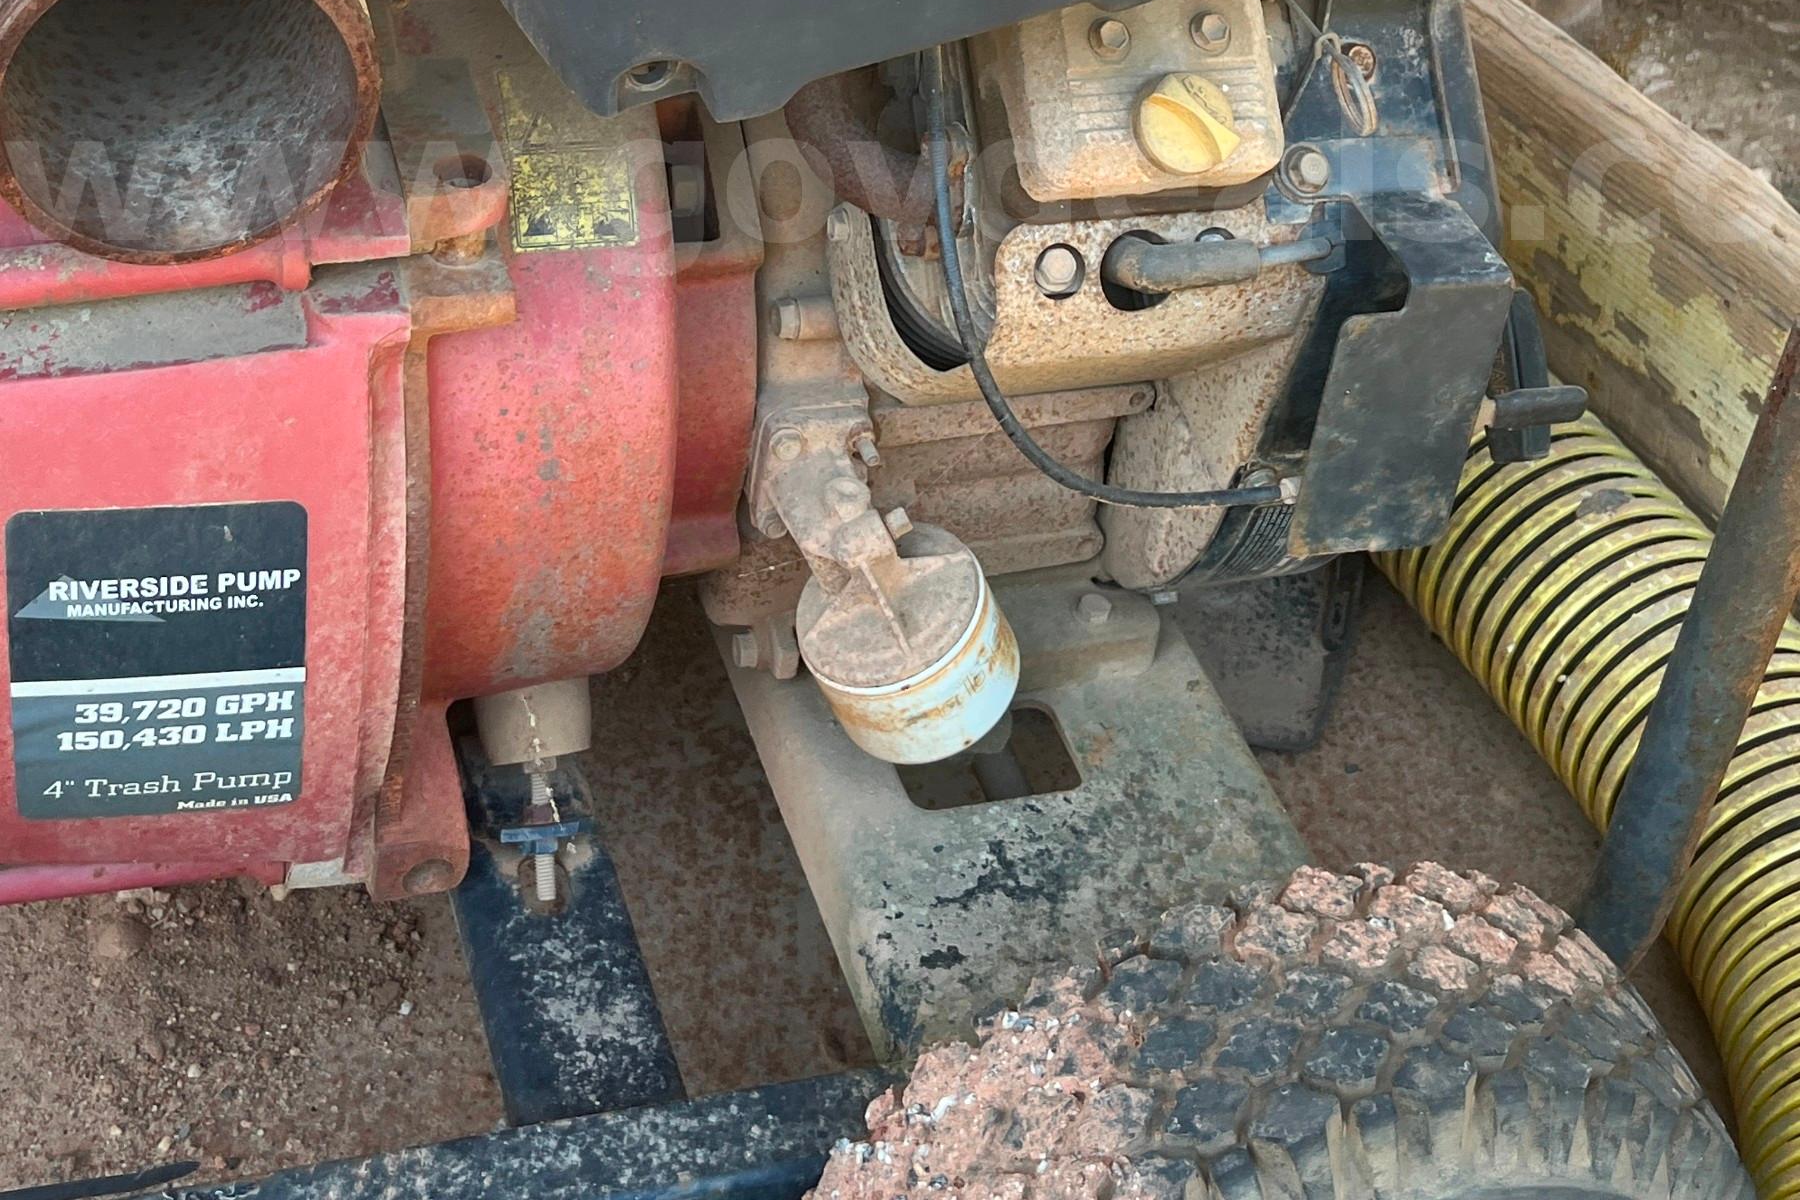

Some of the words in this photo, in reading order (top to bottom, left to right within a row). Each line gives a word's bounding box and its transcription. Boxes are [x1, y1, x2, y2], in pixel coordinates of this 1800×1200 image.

[48, 574, 208, 601] RIVERSIDE
[217, 568, 301, 593] PUMP
[67, 597, 222, 618] MANUFACTURING
[227, 594, 264, 609] INC.
[74, 696, 207, 724] 39,720
[215, 690, 295, 716] GPH
[57, 724, 207, 751] 150,430
[215, 717, 294, 742] LPH
[43, 779, 75, 799] 4"
[84, 775, 182, 798] Trash
[191, 771, 292, 791] Pump
[177, 799, 226, 810] Made
[230, 797, 249, 806] in
[254, 793, 293, 804] USA
